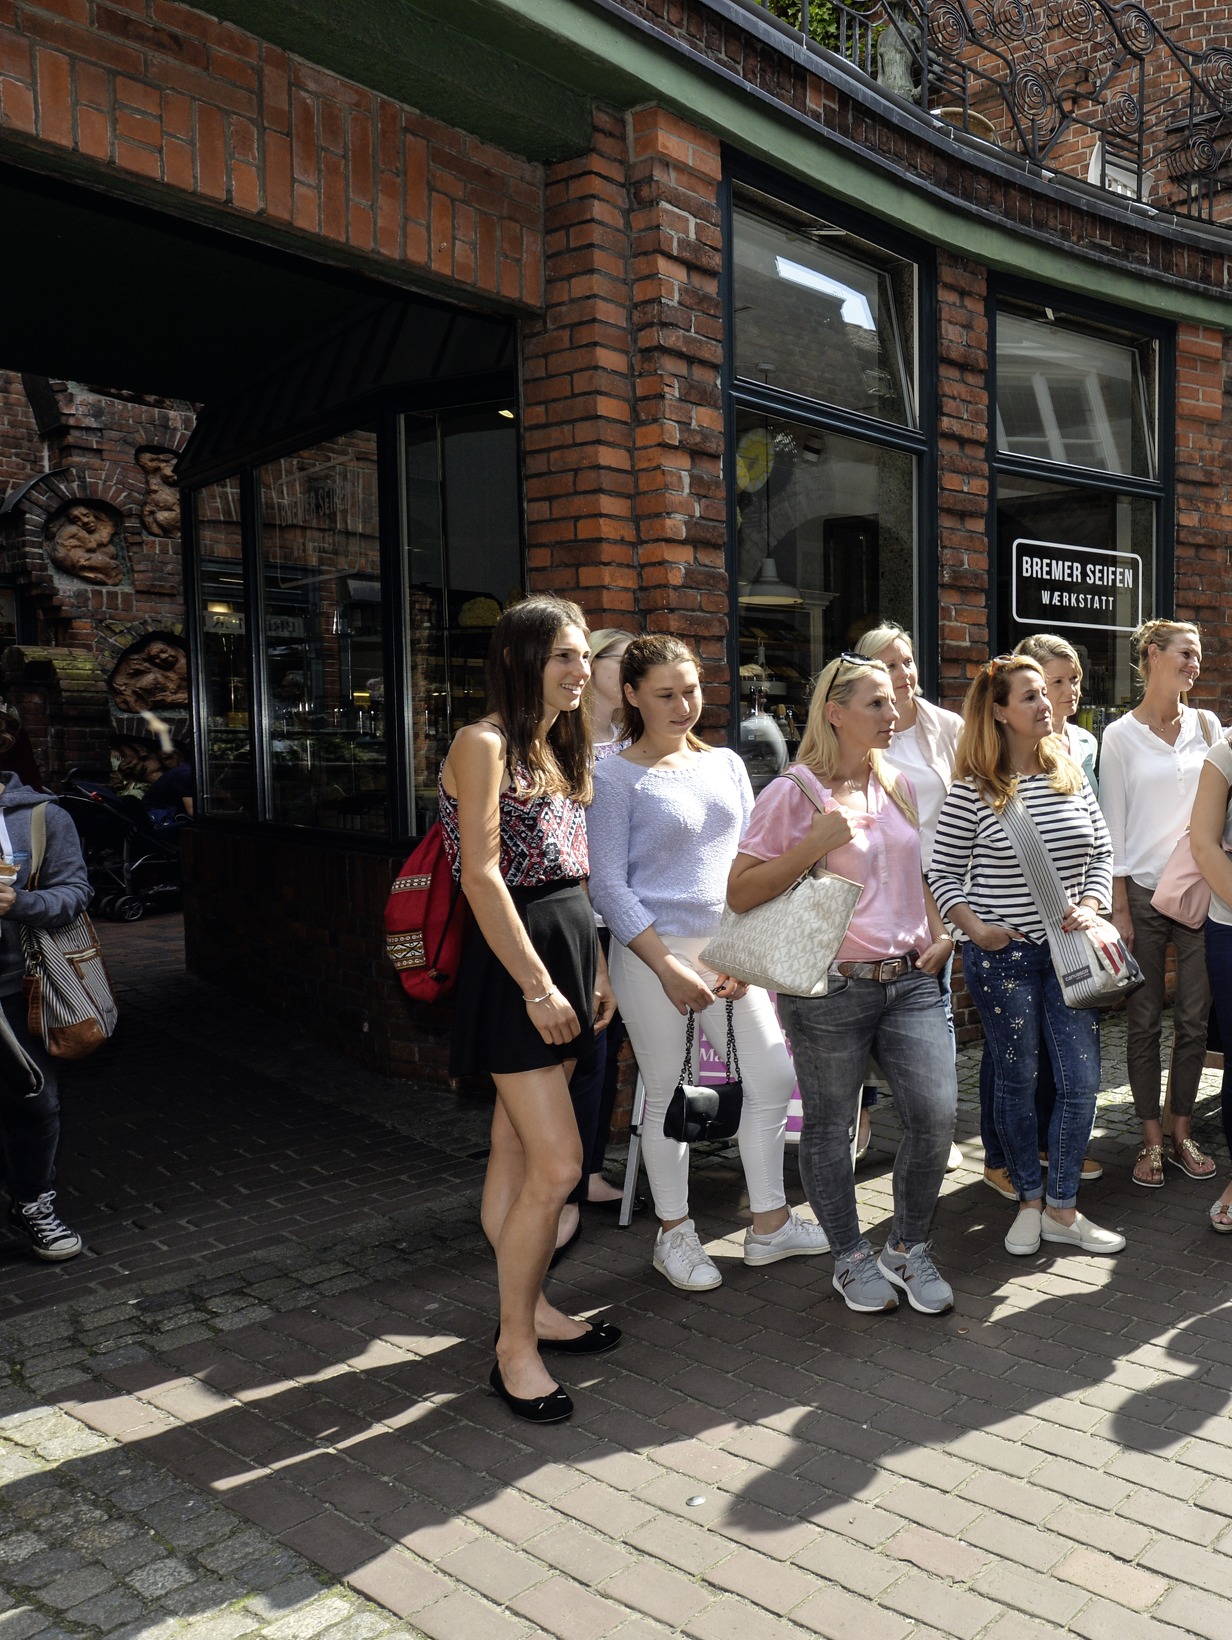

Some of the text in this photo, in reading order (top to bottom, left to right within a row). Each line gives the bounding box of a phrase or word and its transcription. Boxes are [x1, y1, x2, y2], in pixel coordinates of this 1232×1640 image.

[1022, 556, 1133, 589] BREMER SEIFEN
[1041, 590, 1114, 611] WÆRKSTATT
